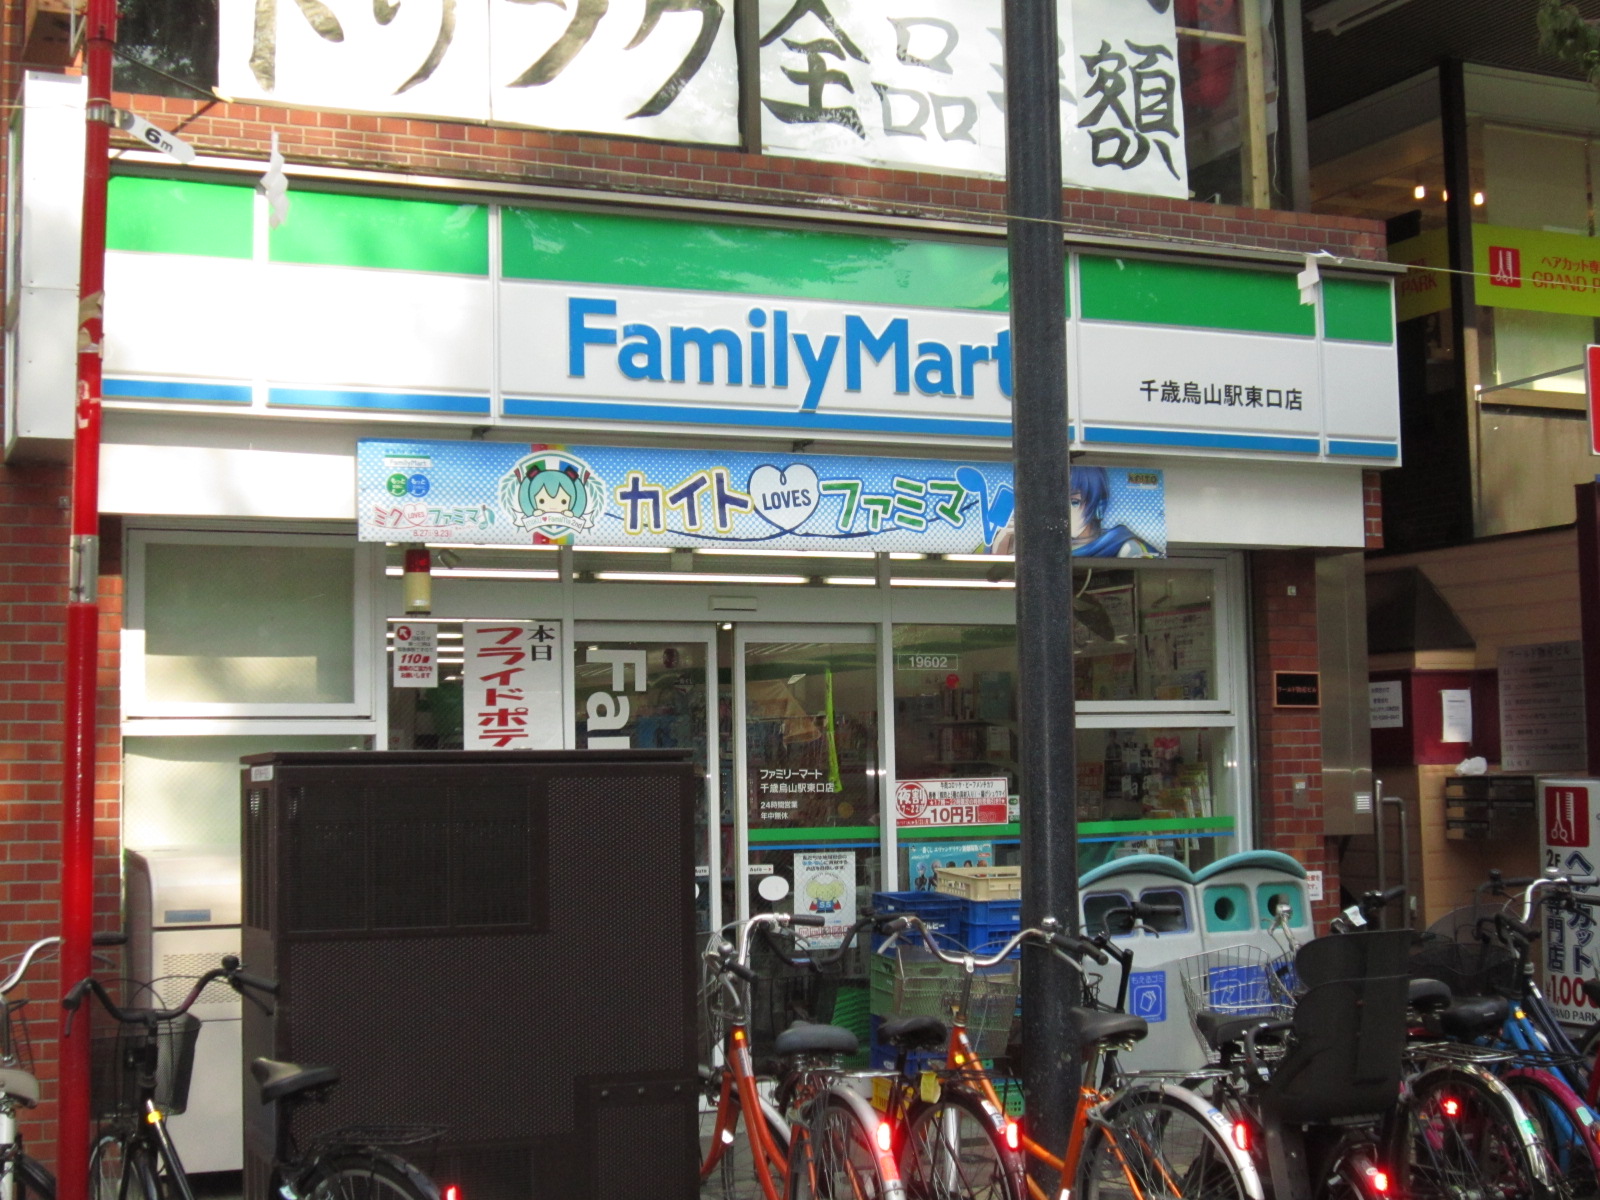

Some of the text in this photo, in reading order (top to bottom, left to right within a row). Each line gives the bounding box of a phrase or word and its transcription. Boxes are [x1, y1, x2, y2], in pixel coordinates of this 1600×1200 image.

[1532, 270, 1588, 293] GRAND
[1139, 379, 1303, 412] 千歳烏山駅東口店
[617, 470, 967, 531] カイト LOVES ファミマ
[374, 506, 480, 527] ミク LOVES ファミマ
[527, 624, 555, 661] 本日
[908, 656, 948, 668] 19602
[586, 650, 646, 749] Fa
[760, 768, 823, 780] ファミリーマート
[760, 782, 834, 794] 千歳烏山駅東口店
[760, 801, 798, 809] 24時間営業
[760, 812, 789, 820] 年中無休
[1546, 849, 1561, 867] 2F
[1565, 851, 1595, 975] ヘカット
[1131, 973, 1166, 985] もえるゴミ
[1573, 1010, 1598, 1022] PARK
